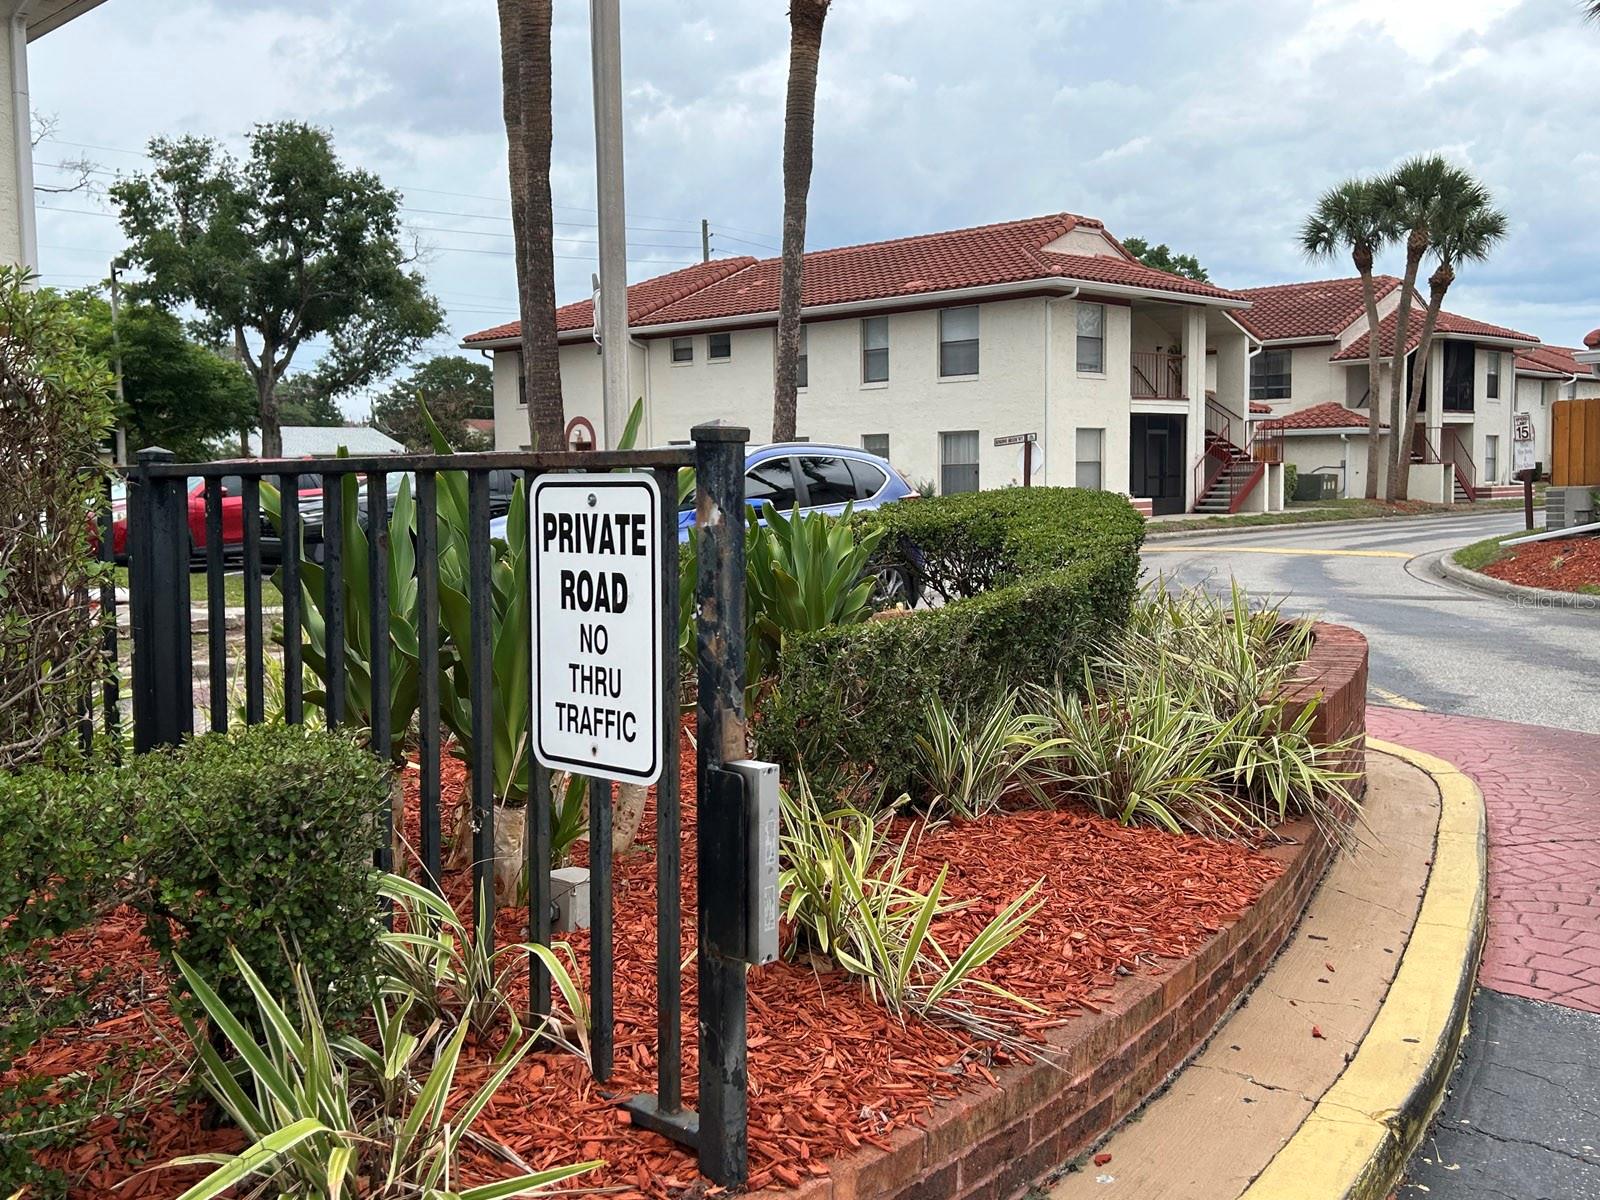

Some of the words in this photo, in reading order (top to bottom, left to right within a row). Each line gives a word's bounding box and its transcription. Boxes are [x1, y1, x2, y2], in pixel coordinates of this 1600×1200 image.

[1516, 426, 1529, 438] 15
[543, 513, 646, 556] PRIVATE
[560, 569, 628, 614] ROAD
[580, 623, 608, 655] NO
[568, 663, 621, 699] THRU
[555, 702, 637, 742] TRAFFIC
